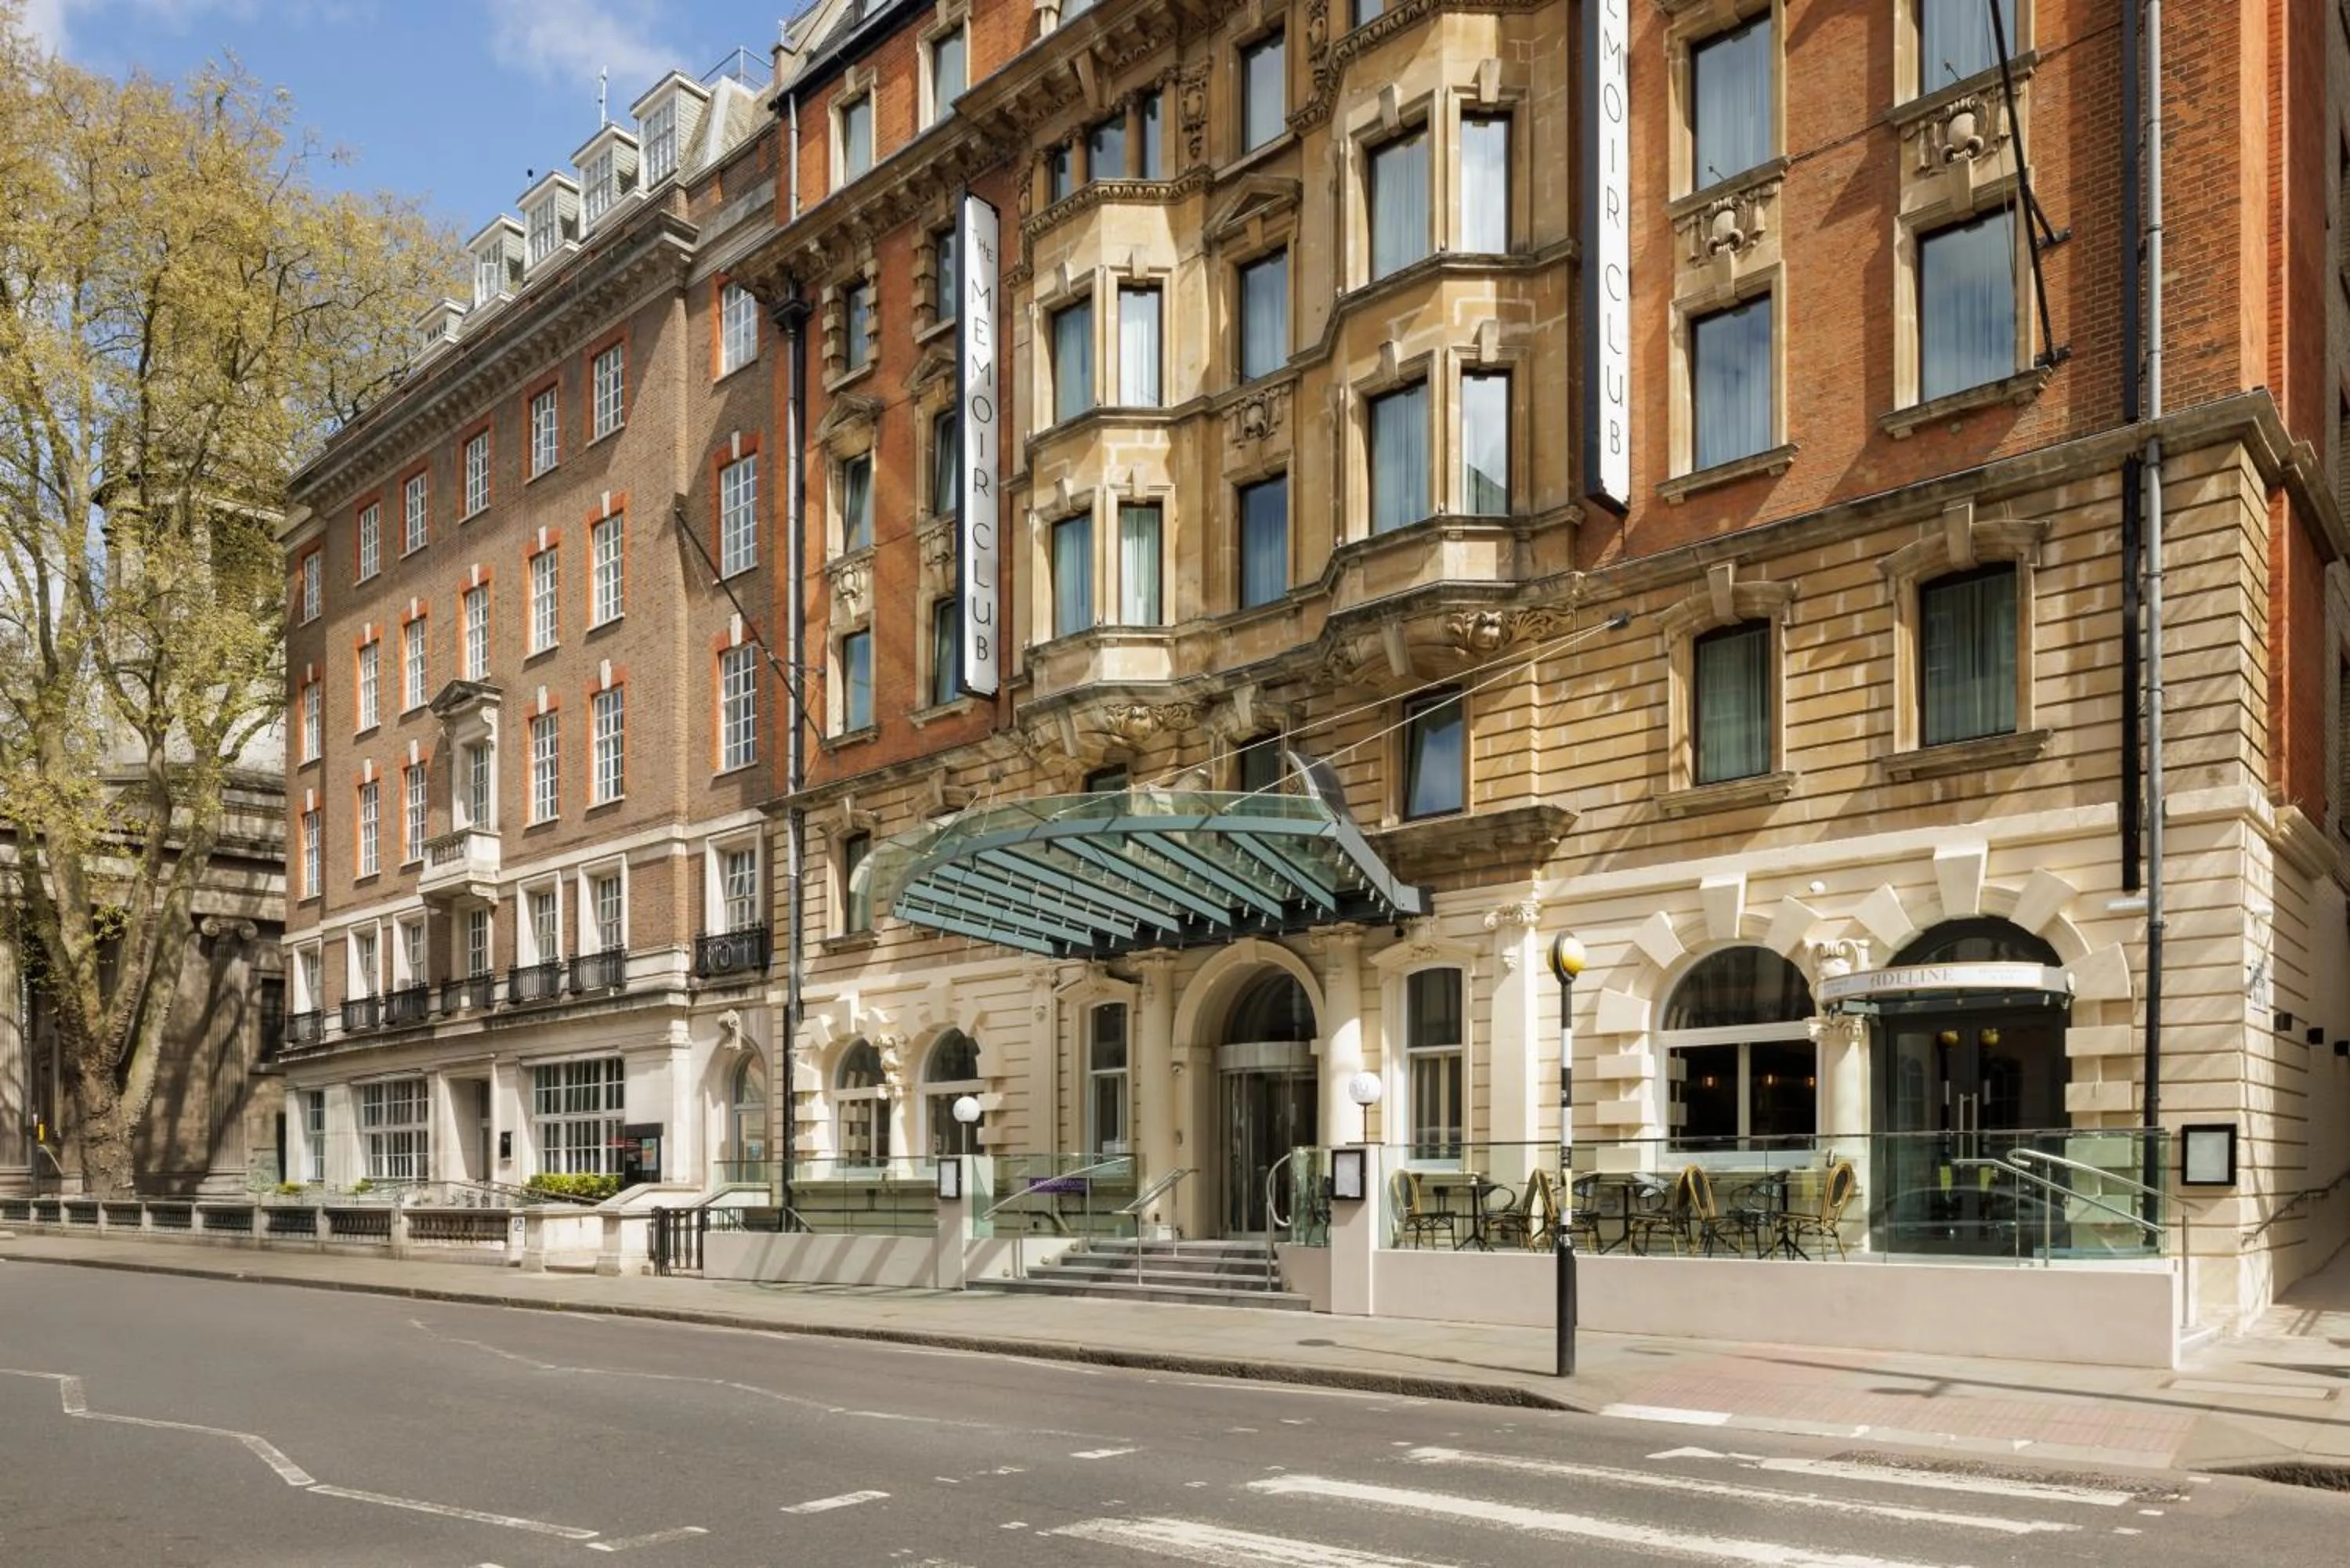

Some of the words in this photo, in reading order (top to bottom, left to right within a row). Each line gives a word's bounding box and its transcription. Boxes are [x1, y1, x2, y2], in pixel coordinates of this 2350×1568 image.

[970, 227, 993, 263] THE
[971, 279, 992, 498] MEMOIR
[1606, 262, 1623, 456] CLUB
[972, 522, 991, 662] CLUB
